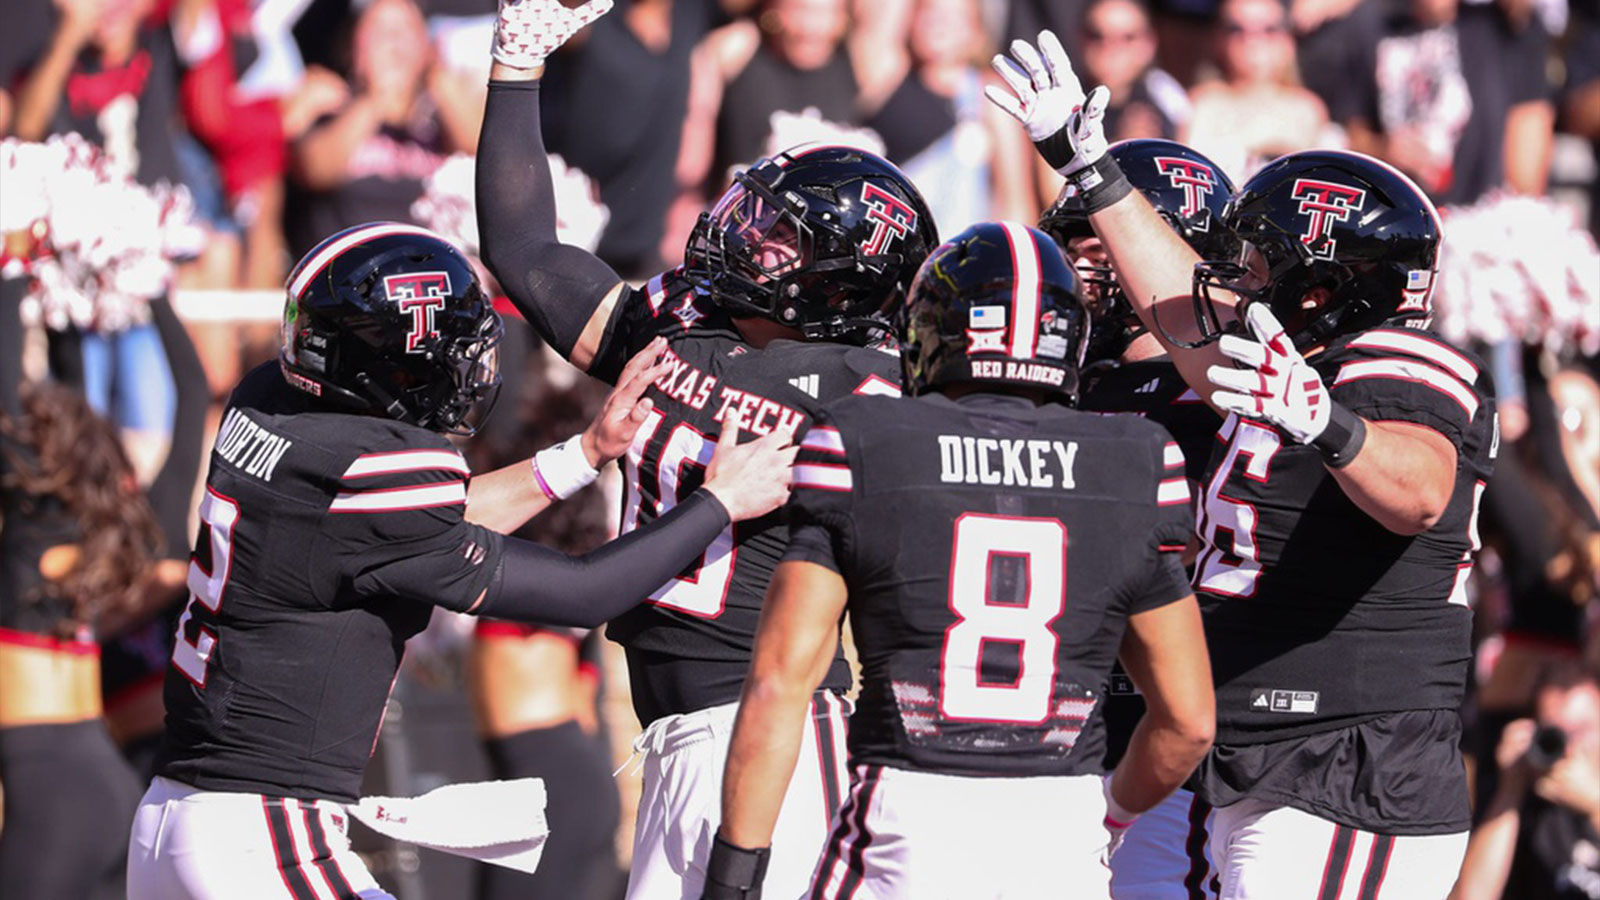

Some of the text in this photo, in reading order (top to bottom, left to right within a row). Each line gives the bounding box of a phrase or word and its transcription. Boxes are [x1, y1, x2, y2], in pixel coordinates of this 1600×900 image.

[654, 346, 806, 437] EXAS TECH
[971, 361, 1067, 387] RED RAIDERS
[215, 406, 293, 483] MORTON
[938, 435, 1079, 490] DICKEY
[172, 483, 242, 690] 2
[938, 511, 1068, 726] 8
